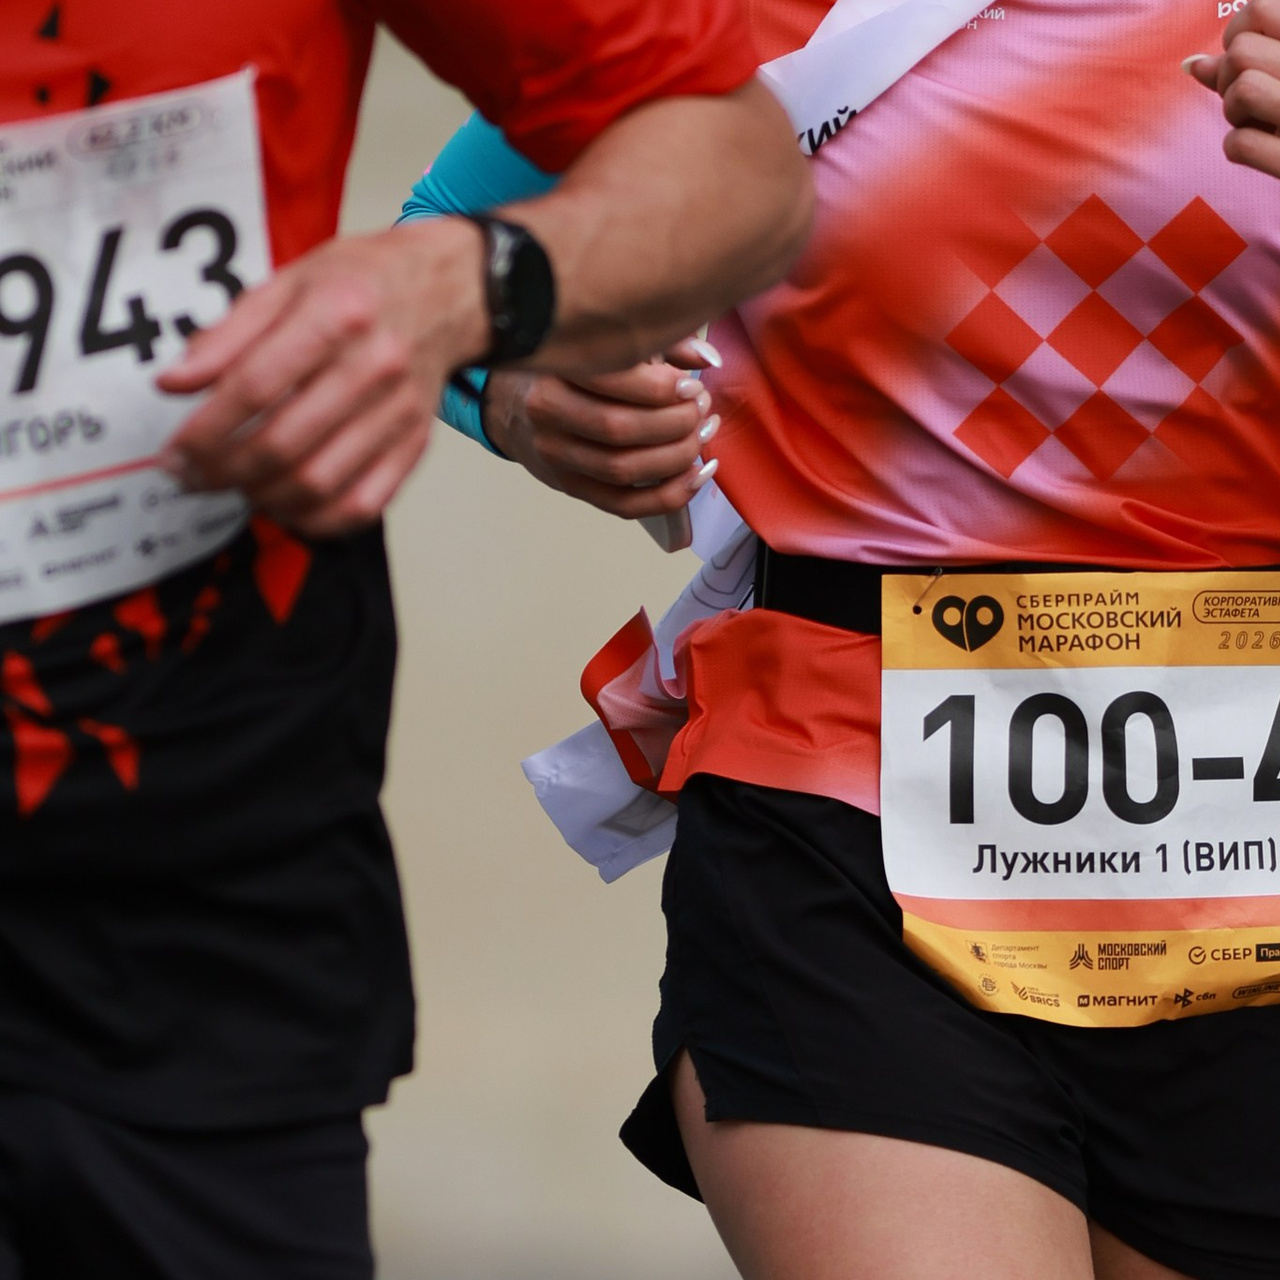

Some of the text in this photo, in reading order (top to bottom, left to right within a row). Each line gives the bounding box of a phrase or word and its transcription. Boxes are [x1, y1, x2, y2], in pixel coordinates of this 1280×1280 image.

[0, 406, 104, 458] ГОРЬ
[1016, 590, 1139, 608] СБЕРПРАЙМ
[1017, 607, 1181, 630] МОСКОВСКИЙ
[1203, 607, 1260, 618] ЭСТАФЕТА
[1019, 633, 1140, 652] МАРАФОН
[972, 837, 1278, 881] Лужники 1 (ВИП)
[991, 944, 1040, 953] Департамент
[1097, 940, 1167, 956] МОСКОВСКИЙ
[1211, 947, 1252, 961] СБЕР
[1097, 957, 1131, 970] СПОРТ
[1029, 994, 1060, 1008] BRICS
[1092, 994, 1158, 1007] магнит
[1195, 992, 1216, 1001] сбп
